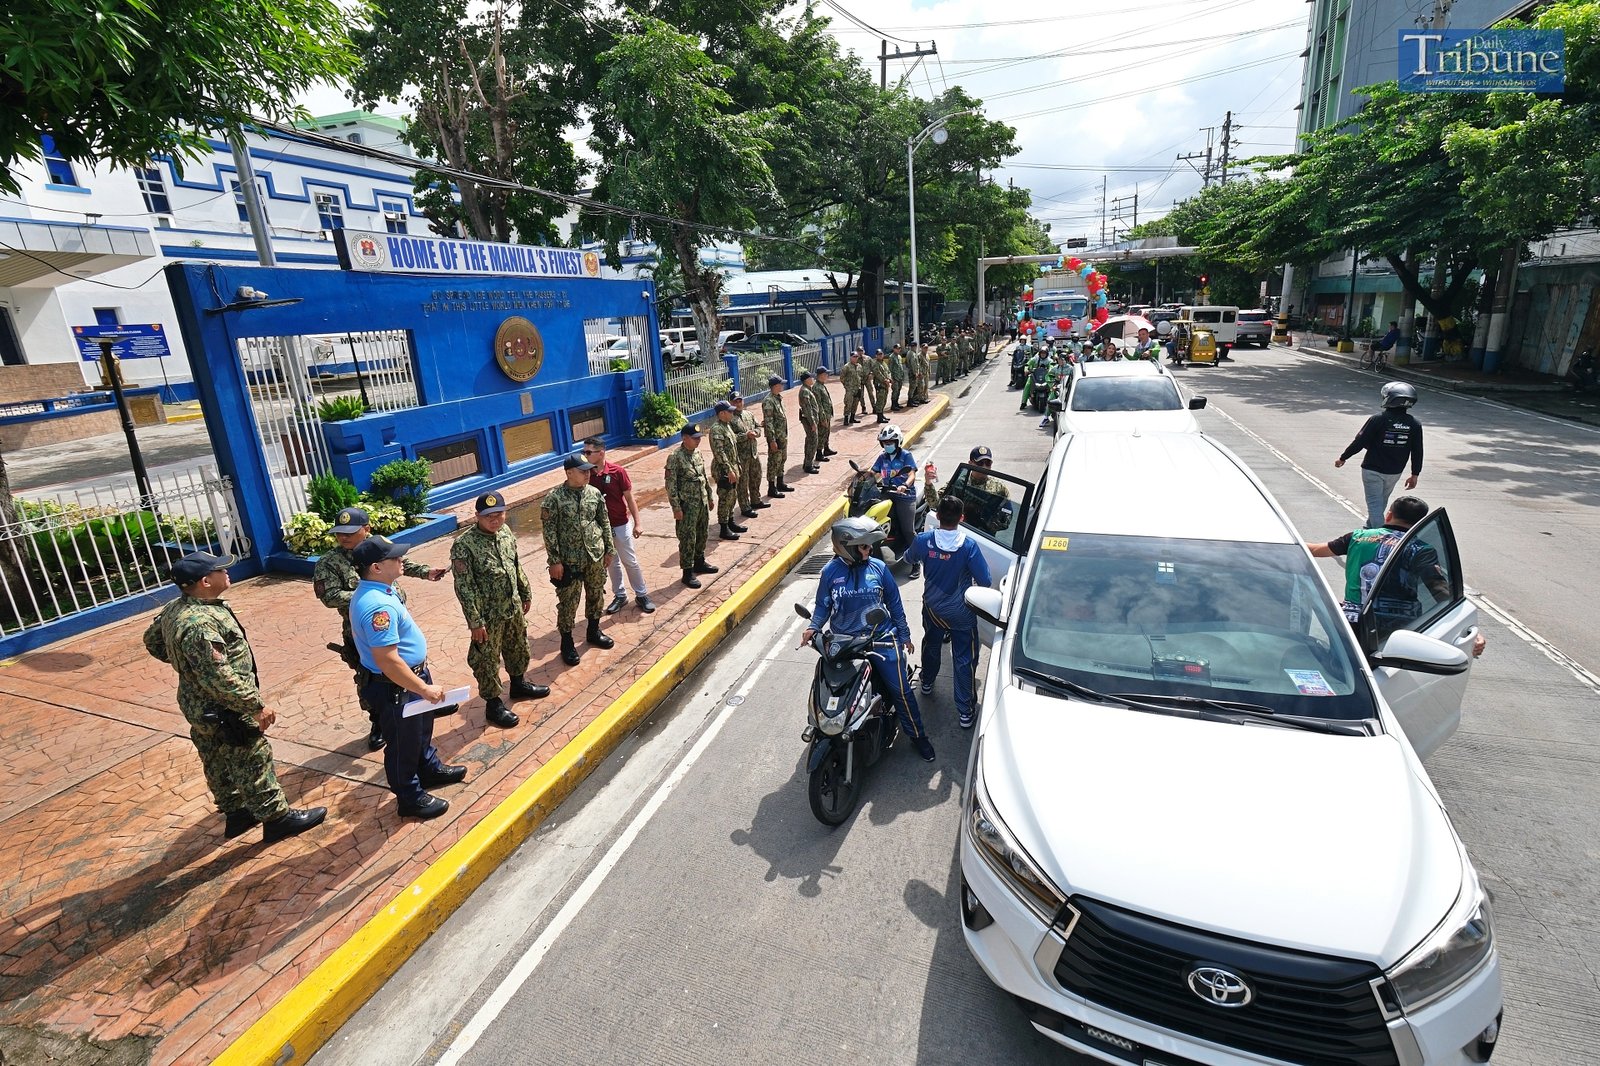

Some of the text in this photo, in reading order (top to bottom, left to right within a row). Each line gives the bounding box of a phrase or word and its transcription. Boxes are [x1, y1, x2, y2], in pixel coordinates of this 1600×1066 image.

[386, 236, 439, 269] HOME
[438, 240, 458, 270] OF
[459, 242, 489, 271] THE
[547, 250, 583, 275] FINEST
[1048, 539, 1068, 548] 1260
